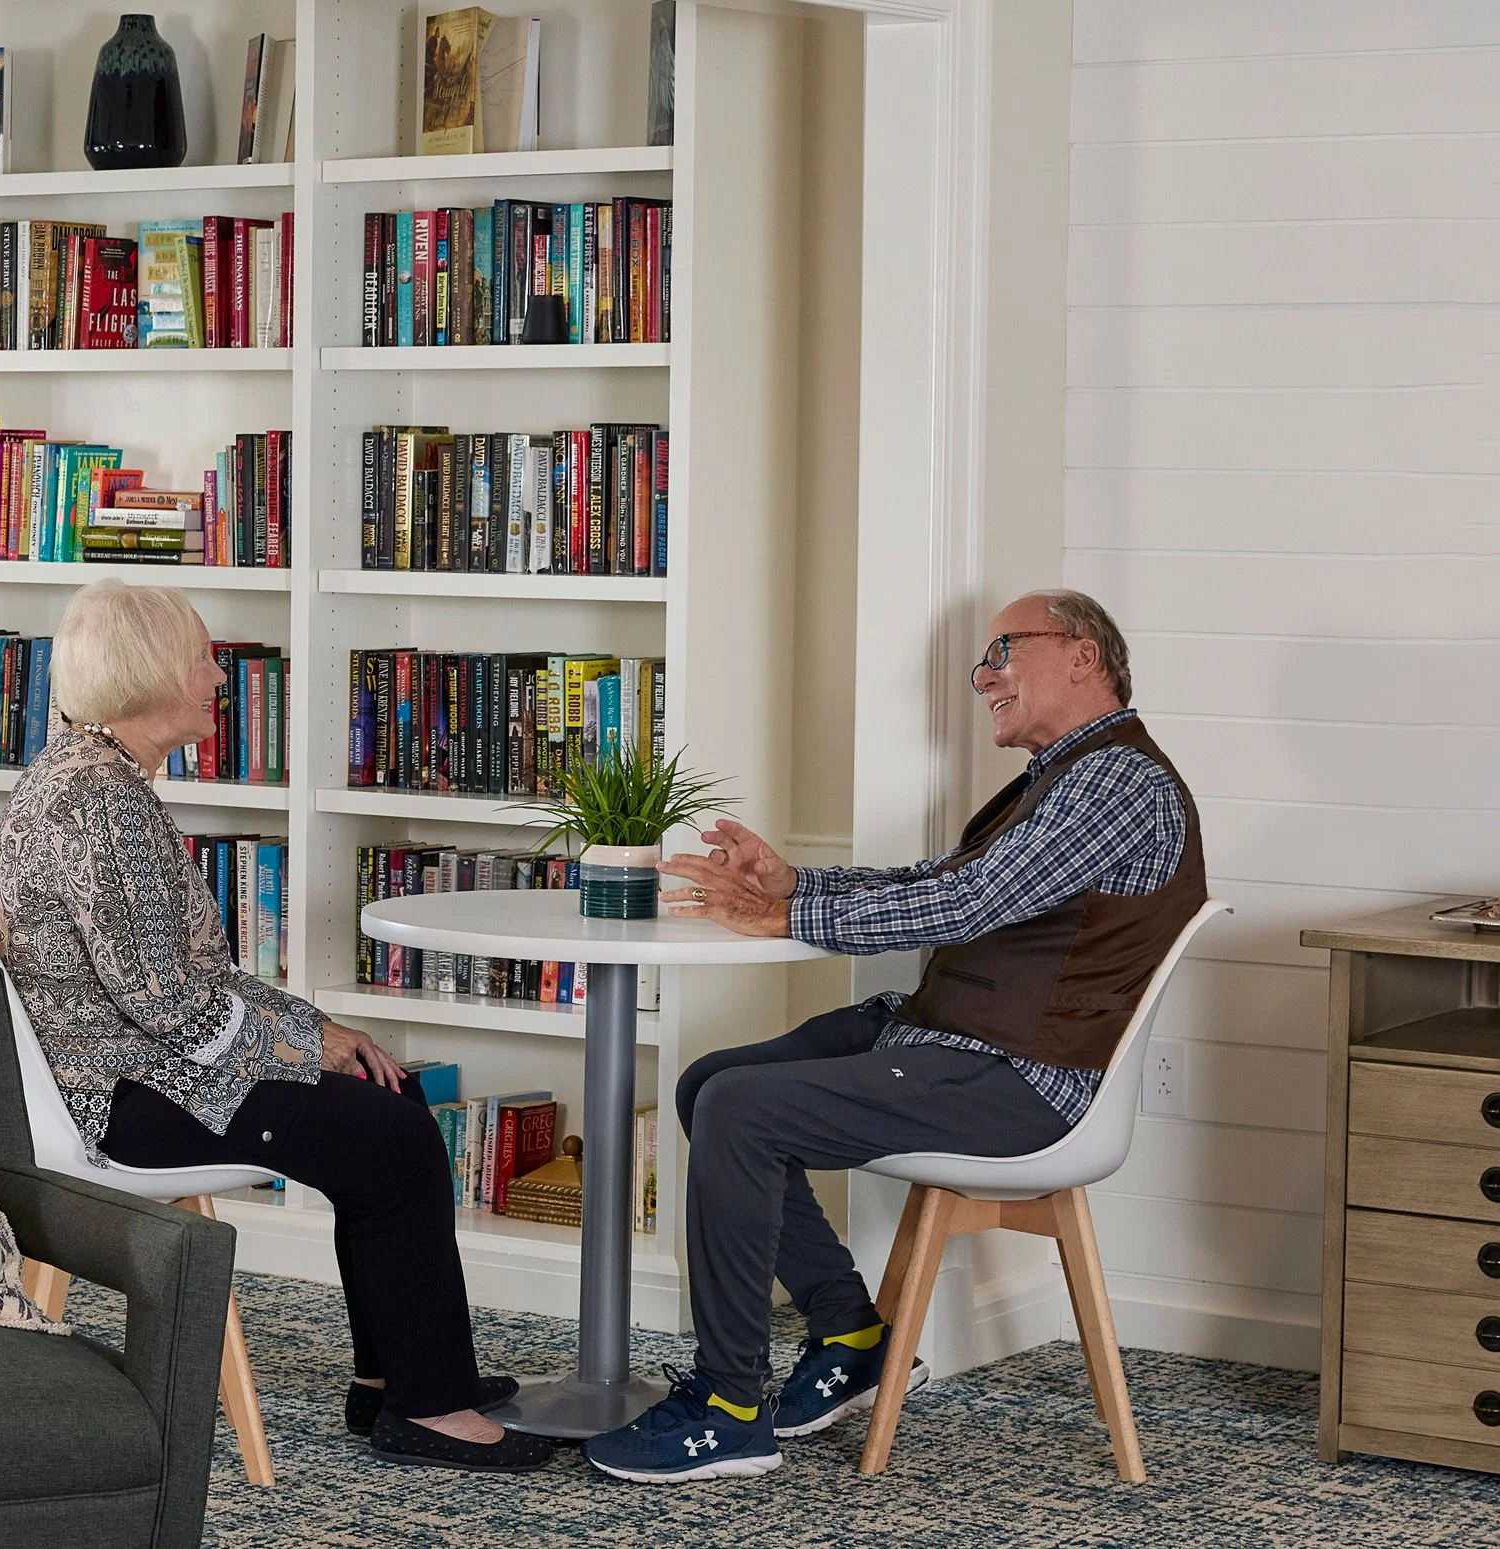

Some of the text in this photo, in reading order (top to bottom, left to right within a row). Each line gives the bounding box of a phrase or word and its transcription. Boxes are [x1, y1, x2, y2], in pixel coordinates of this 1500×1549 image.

[32, 224, 45, 270] DAN BROWN
[415, 219, 429, 260] RIVEN
[585, 206, 593, 271] ALAN FURST
[108, 271, 118, 280] THE
[204, 241, 216, 293] IRIS JOHANSEN
[82, 286, 90, 311] FLIGHT
[112, 287, 136, 307] LAS
[364, 272, 378, 330] DEADLOCK
[591, 426, 602, 448] JAMES
[32, 454, 42, 498] EVANOVICH
[364, 438, 374, 508] DAVID BALDACCI
[396, 440, 408, 525] DAVID BALDACCI
[555, 434, 566, 504] VINCE FLYNN
[591, 447, 602, 482] PATTERSON
[204, 480, 215, 523] Janet Evanovich
[442, 476, 450, 508] BALDACCI
[536, 450, 548, 521] DAVID BALDACCI
[656, 439, 669, 568] OUR MAN GEORGE PACKER
[442, 512, 450, 524] THE
[590, 494, 601, 517] ALEX
[256, 506, 267, 555] PHANTOM PREY
[268, 522, 279, 555] FEARED
[590, 519, 601, 550] CROSS
[35, 664, 43, 685] INNER
[377, 658, 389, 722] JAYNE ANN KRENTZ
[509, 676, 519, 688] JOY
[33, 688, 41, 712] CIRCLE
[510, 689, 519, 718] FIELDING
[536, 676, 548, 726] J. D. ROBB
[568, 669, 581, 723] J. D. ROBB
[653, 673, 665, 756] JOY FIELDING THE WILD
[568, 868, 577, 887] Mary
[504, 1119, 514, 1158] GREG ILES
[521, 1112, 554, 1132] GREG
[522, 1131, 551, 1153] ILES
